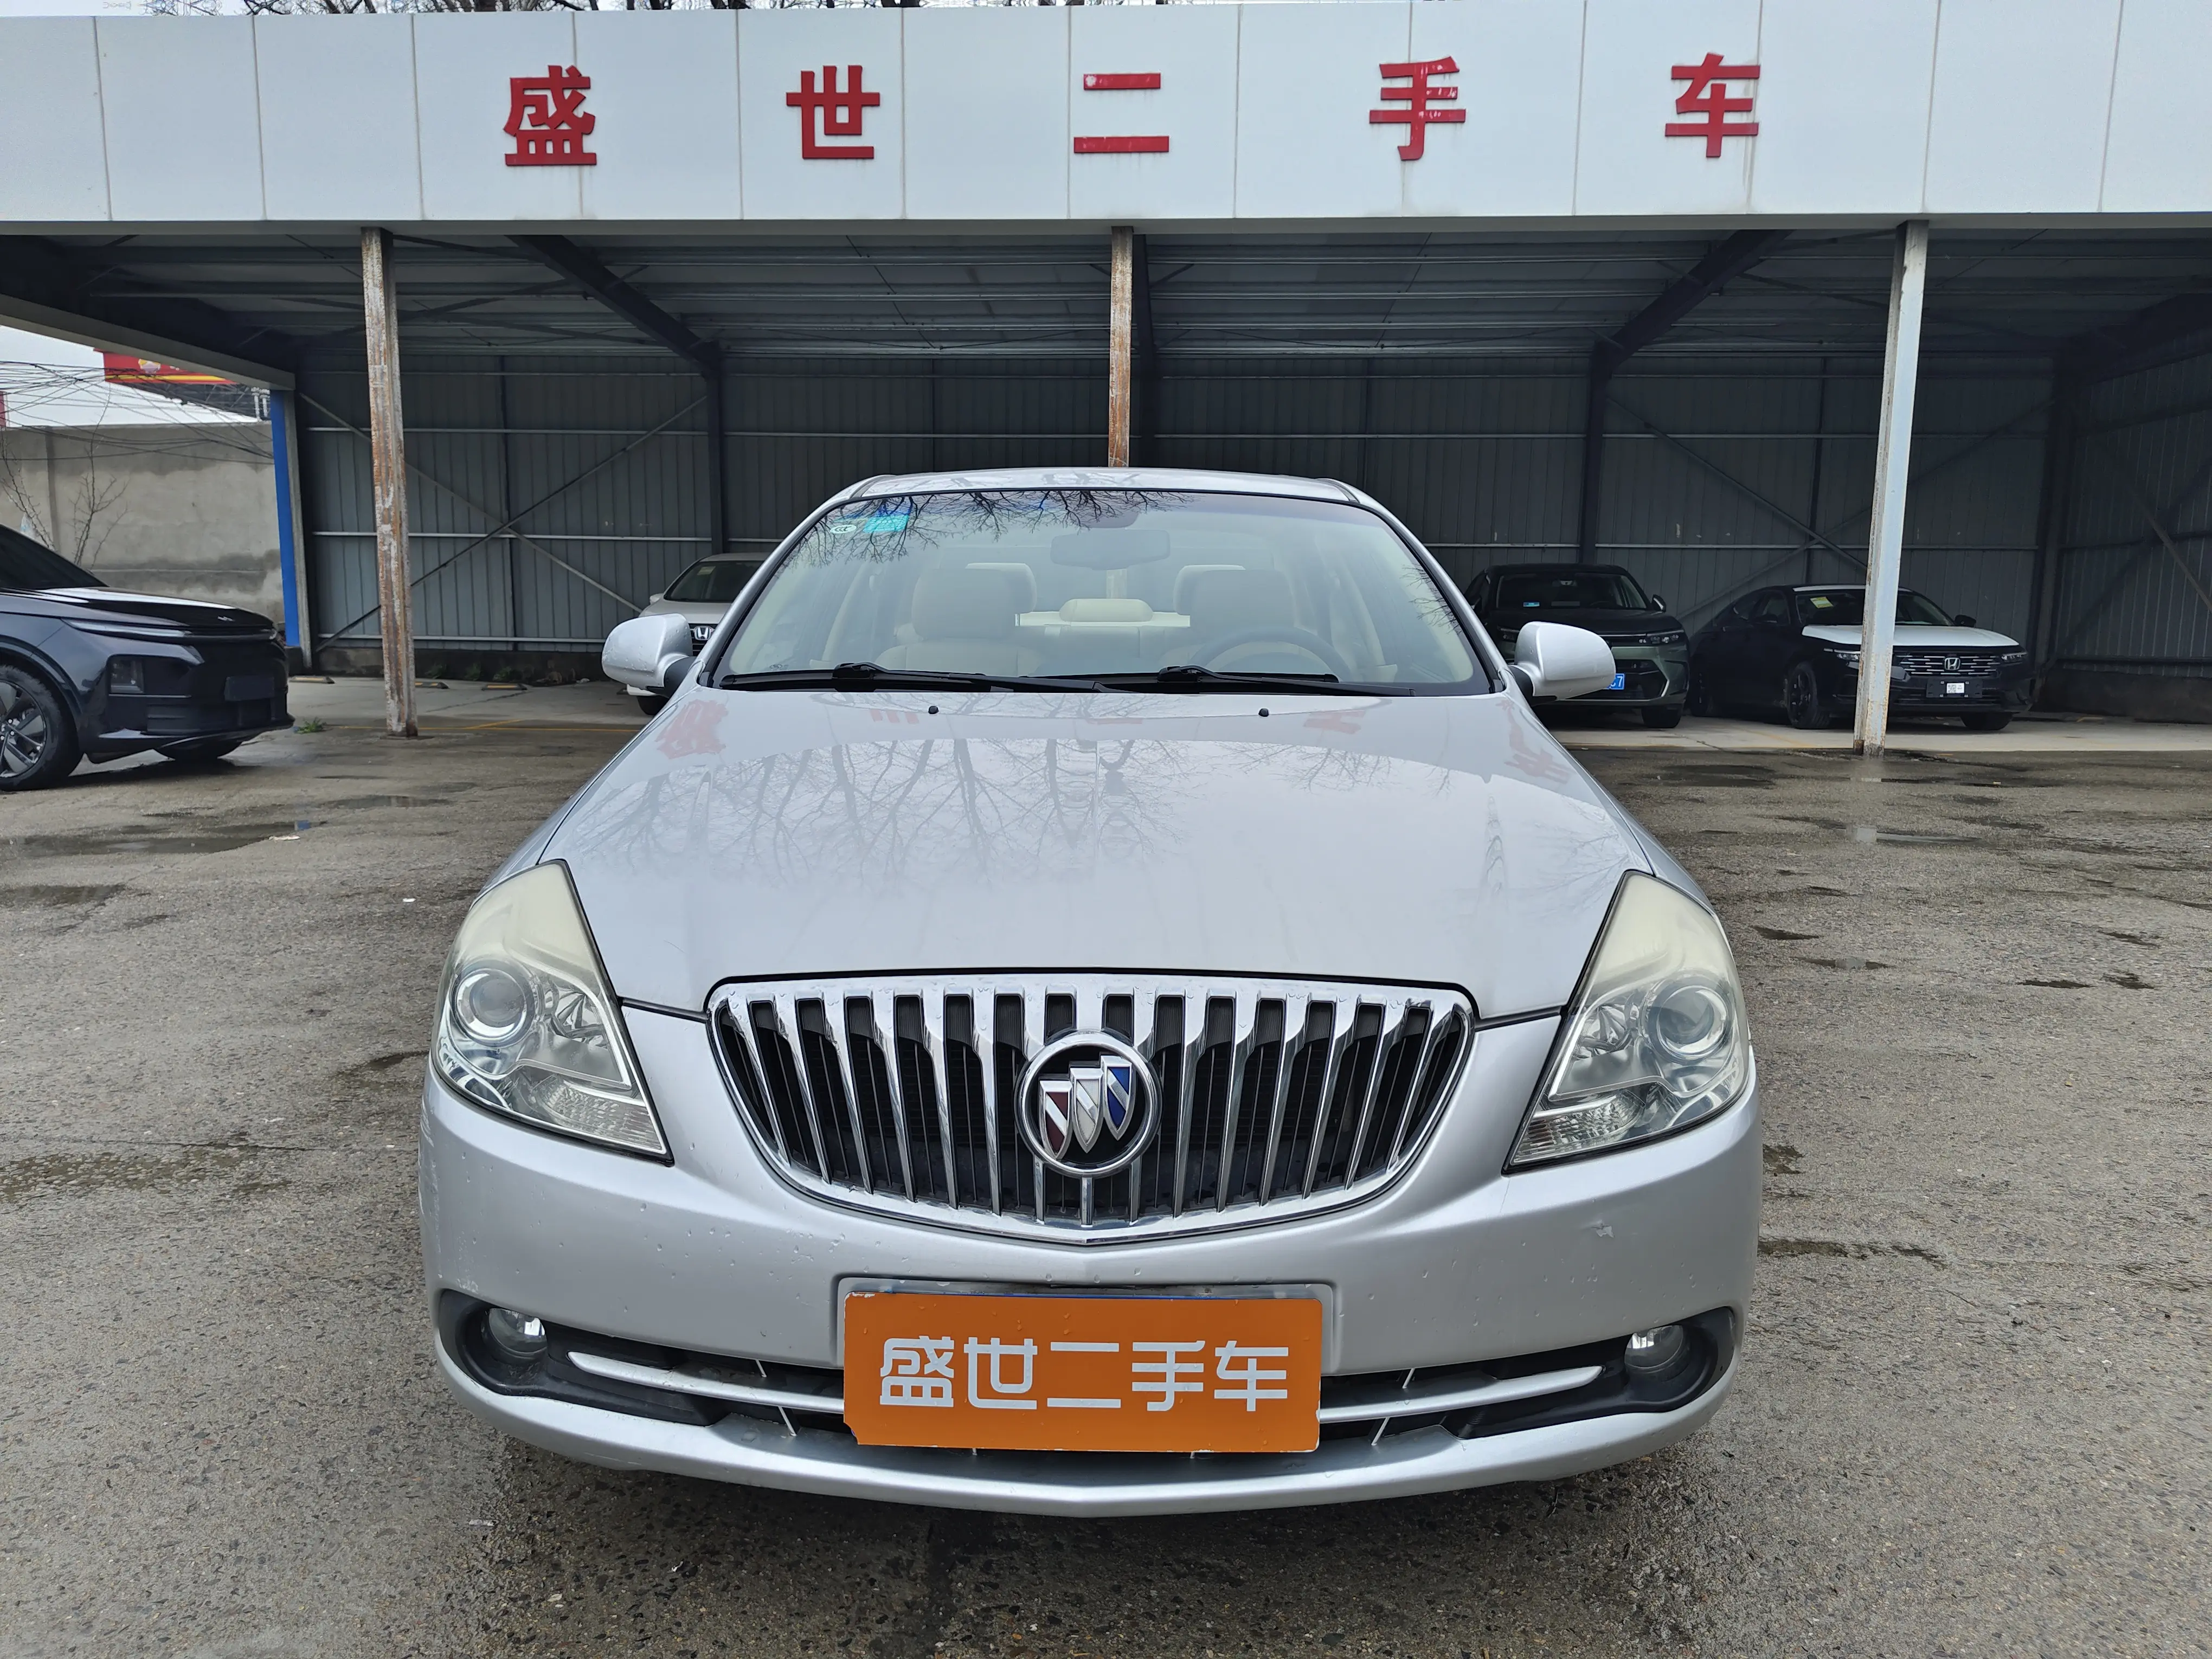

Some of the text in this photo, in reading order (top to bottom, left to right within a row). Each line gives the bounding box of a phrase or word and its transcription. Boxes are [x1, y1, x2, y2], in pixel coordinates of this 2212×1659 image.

[504, 53, 1760, 165] 盛世二手车
[880, 1336, 1288, 1411] 盛世二手车
